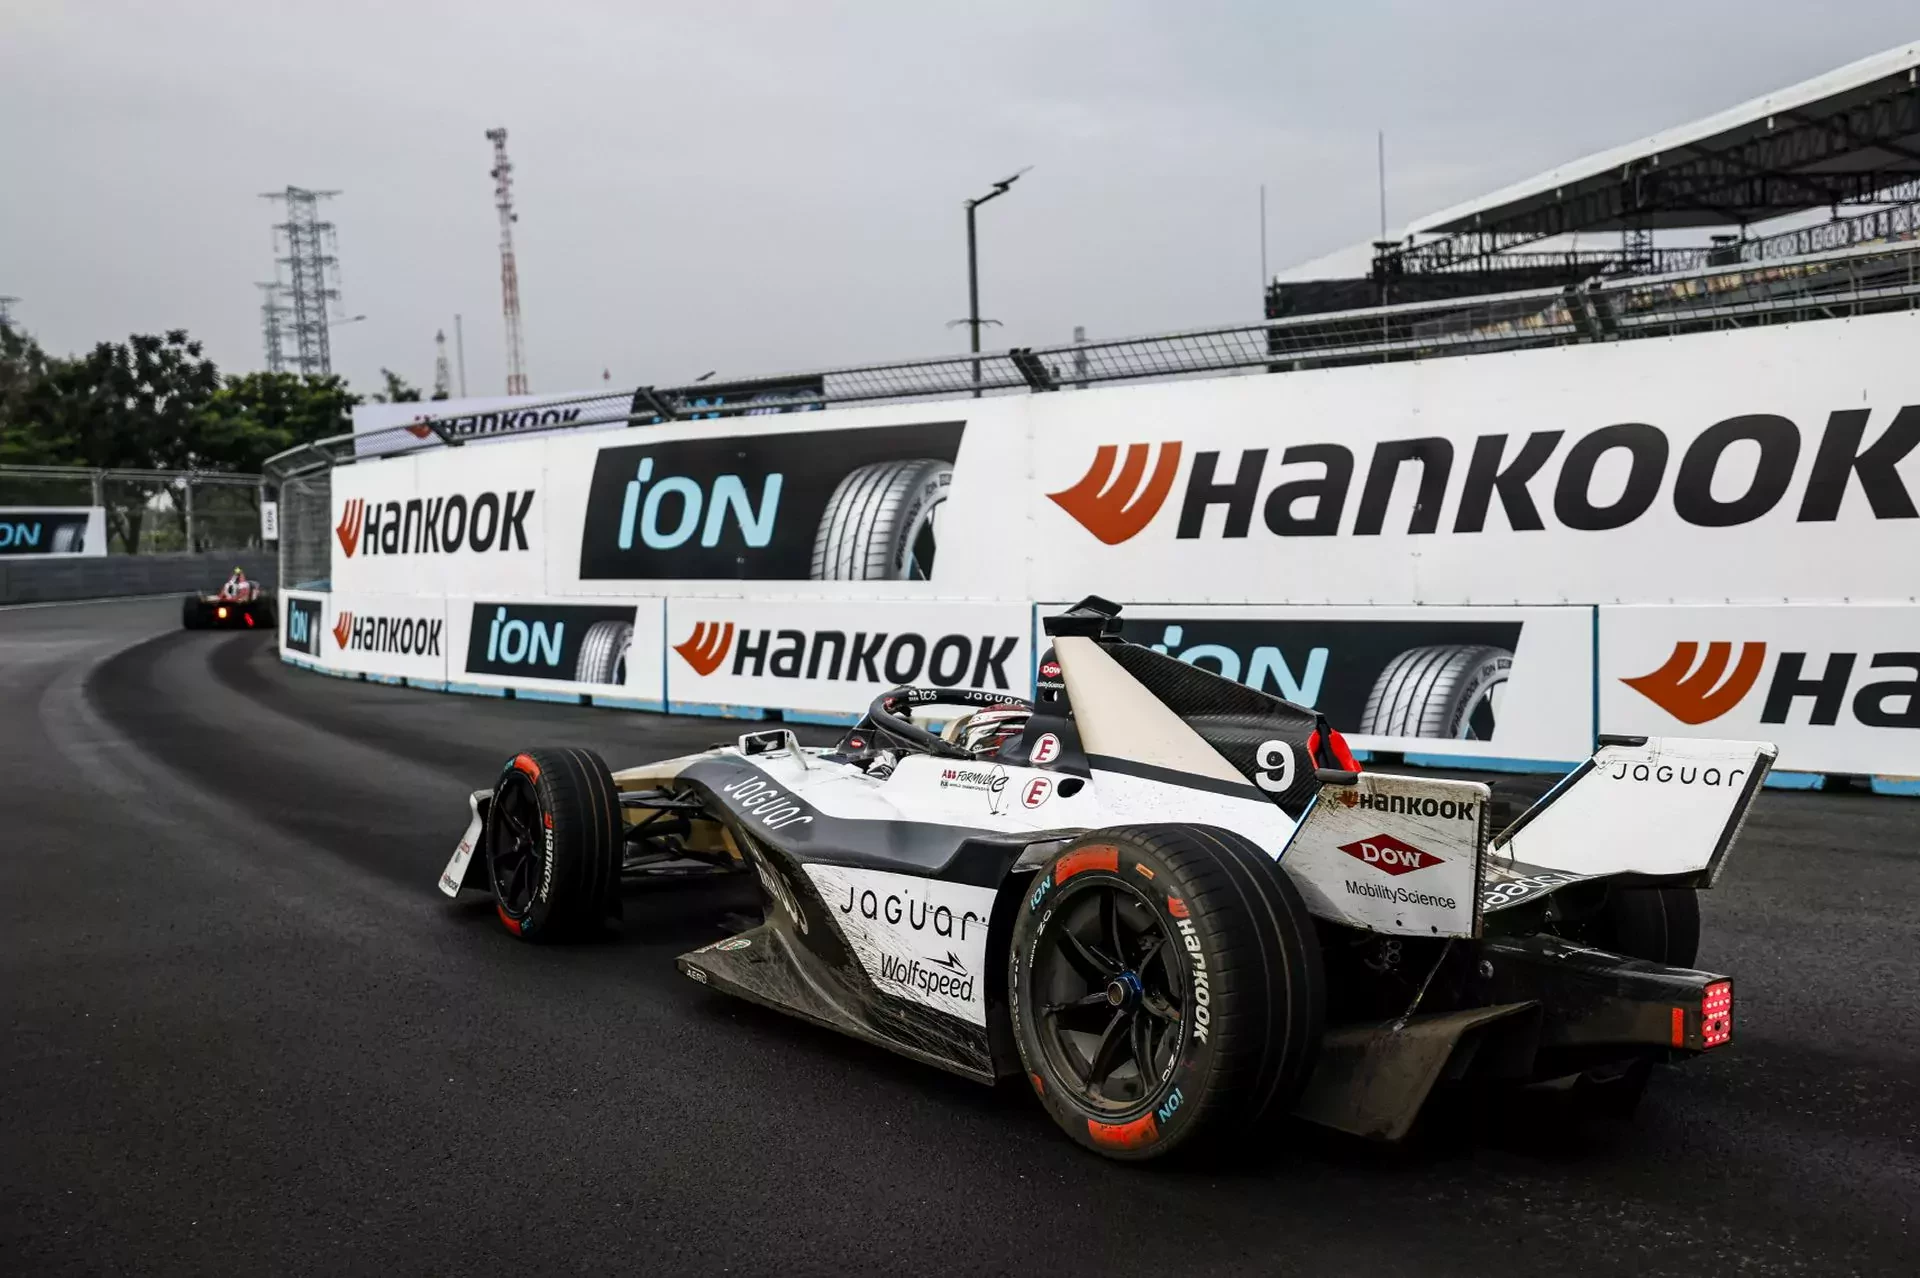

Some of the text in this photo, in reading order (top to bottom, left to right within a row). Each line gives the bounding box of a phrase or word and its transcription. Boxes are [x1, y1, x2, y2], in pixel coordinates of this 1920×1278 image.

[1035, 739, 1053, 761] E
[1255, 740, 1296, 793] 9
[1026, 780, 1047, 805] E
[1345, 880, 1457, 910] MobilityScience
